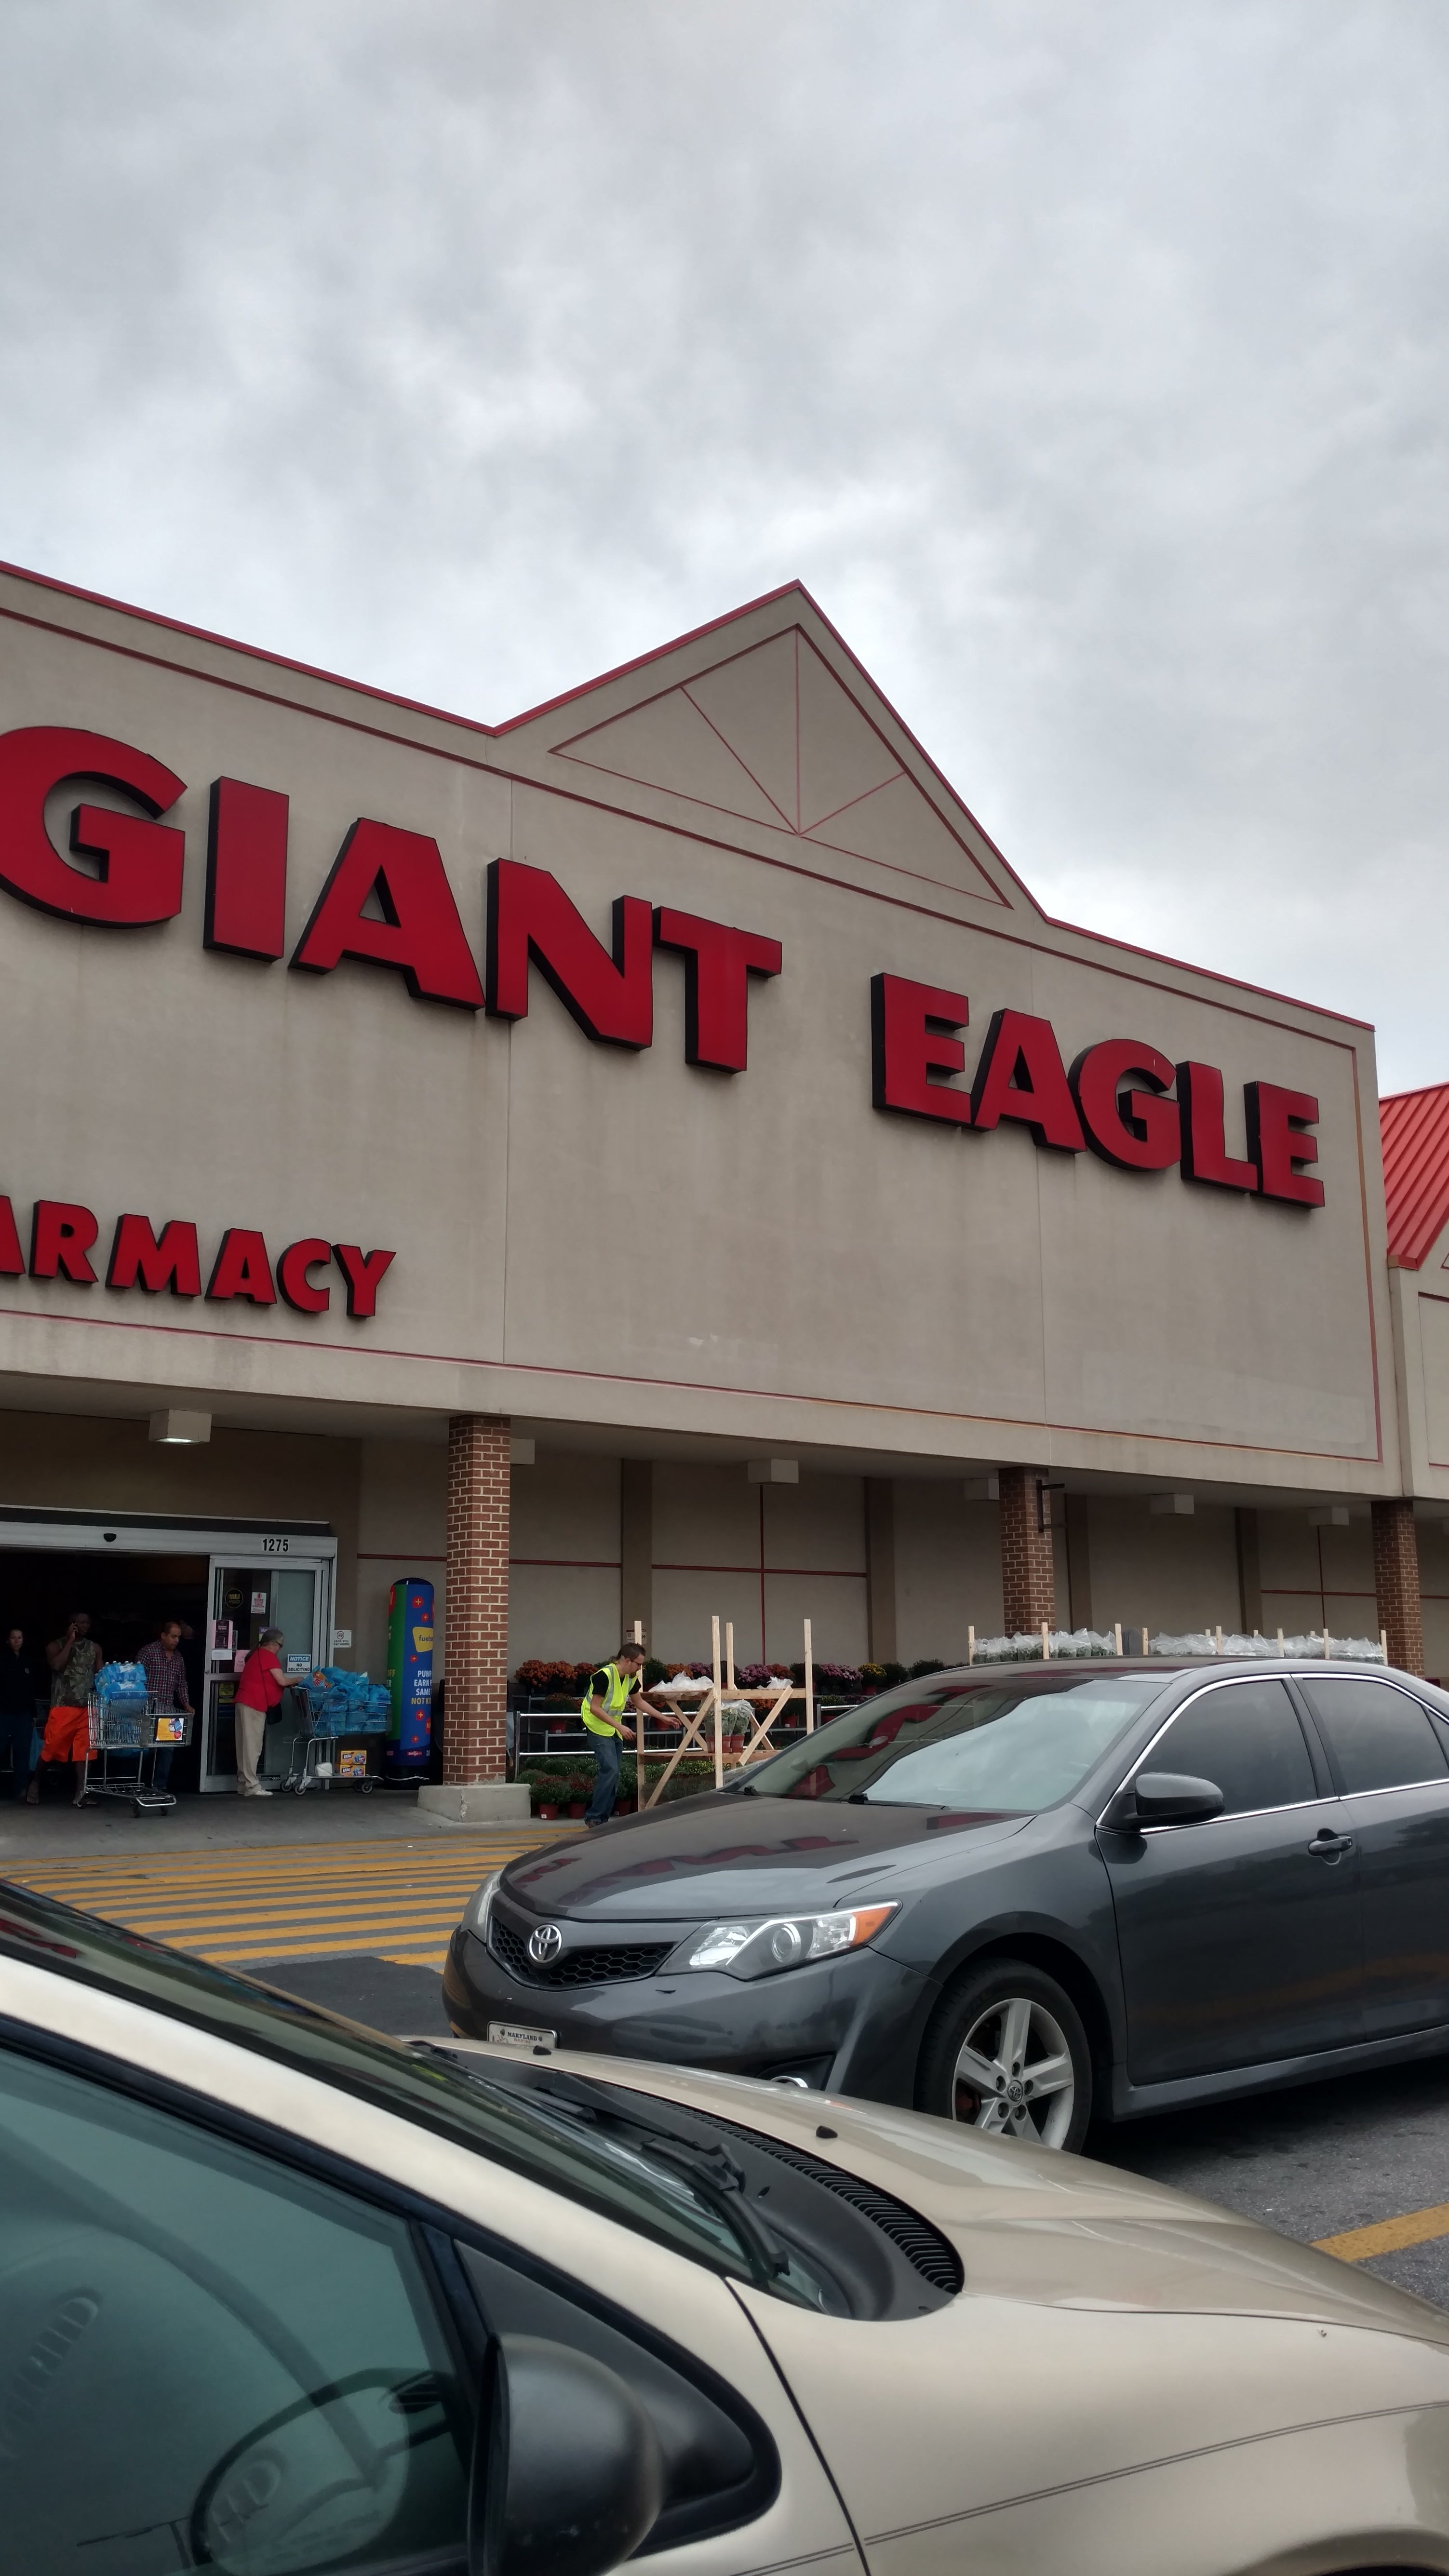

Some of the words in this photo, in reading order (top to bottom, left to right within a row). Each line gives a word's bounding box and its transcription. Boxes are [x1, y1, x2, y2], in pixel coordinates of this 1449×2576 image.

[0, 726, 782, 1075] GIANT
[871, 972, 1325, 1209] EAGLE
[263, 1538, 289, 1552] 1275
[507, 2031, 537, 2041] MARYLAND
